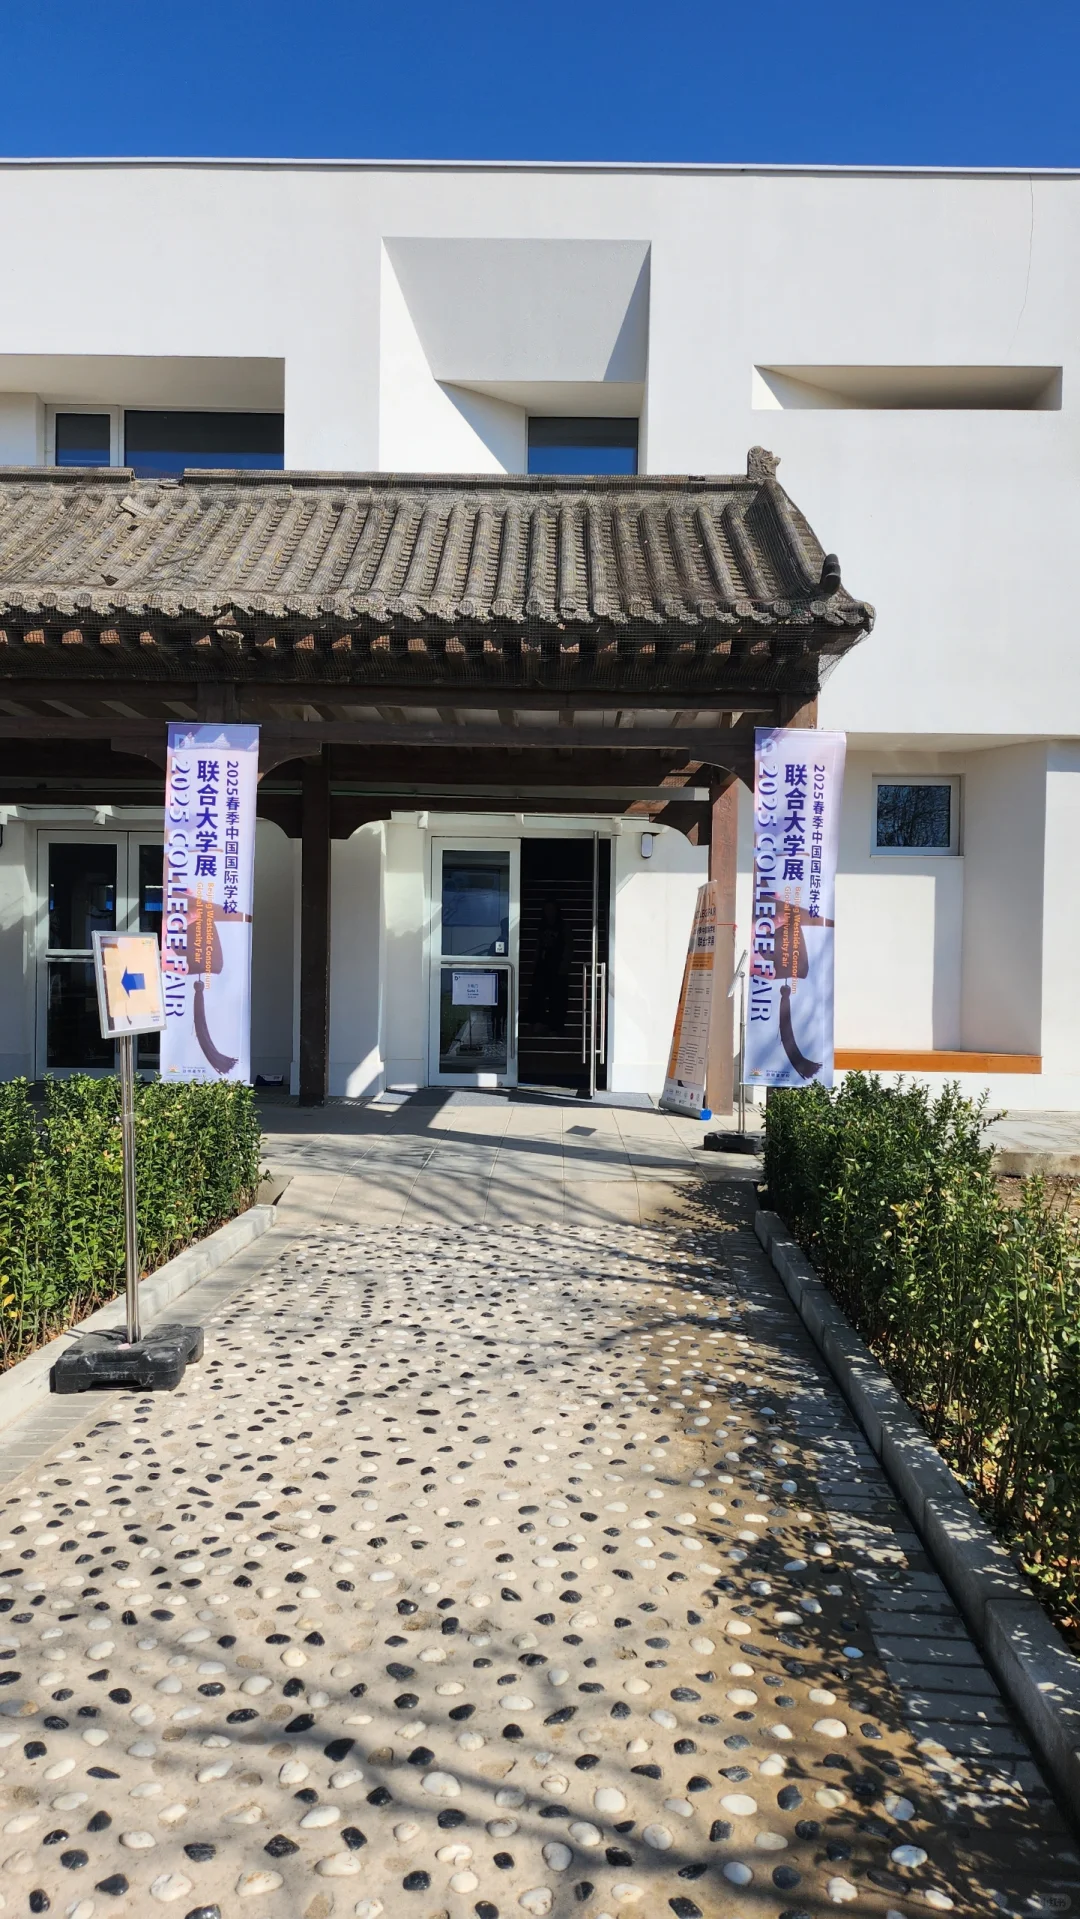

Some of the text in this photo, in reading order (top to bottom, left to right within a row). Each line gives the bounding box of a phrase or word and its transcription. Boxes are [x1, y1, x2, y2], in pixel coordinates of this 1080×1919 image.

[194, 760, 219, 877] 联合大学展
[223, 761, 241, 914] 2025春季中国国际学校
[782, 764, 808, 881] 联合大学展
[808, 765, 825, 918] 2025春季中国国际学校
[165, 757, 191, 1017] 2025 COLLEGE FAIR
[194, 882, 204, 963] Global University Fair
[204, 882, 214, 990] Beijing Westside Consortium
[750, 761, 778, 1022] 2025 COLLEGE FAIR
[781, 912, 791, 951] University
[791, 886, 802, 994] Beijing Westside Consortium
[781, 952, 790, 968] Fair
